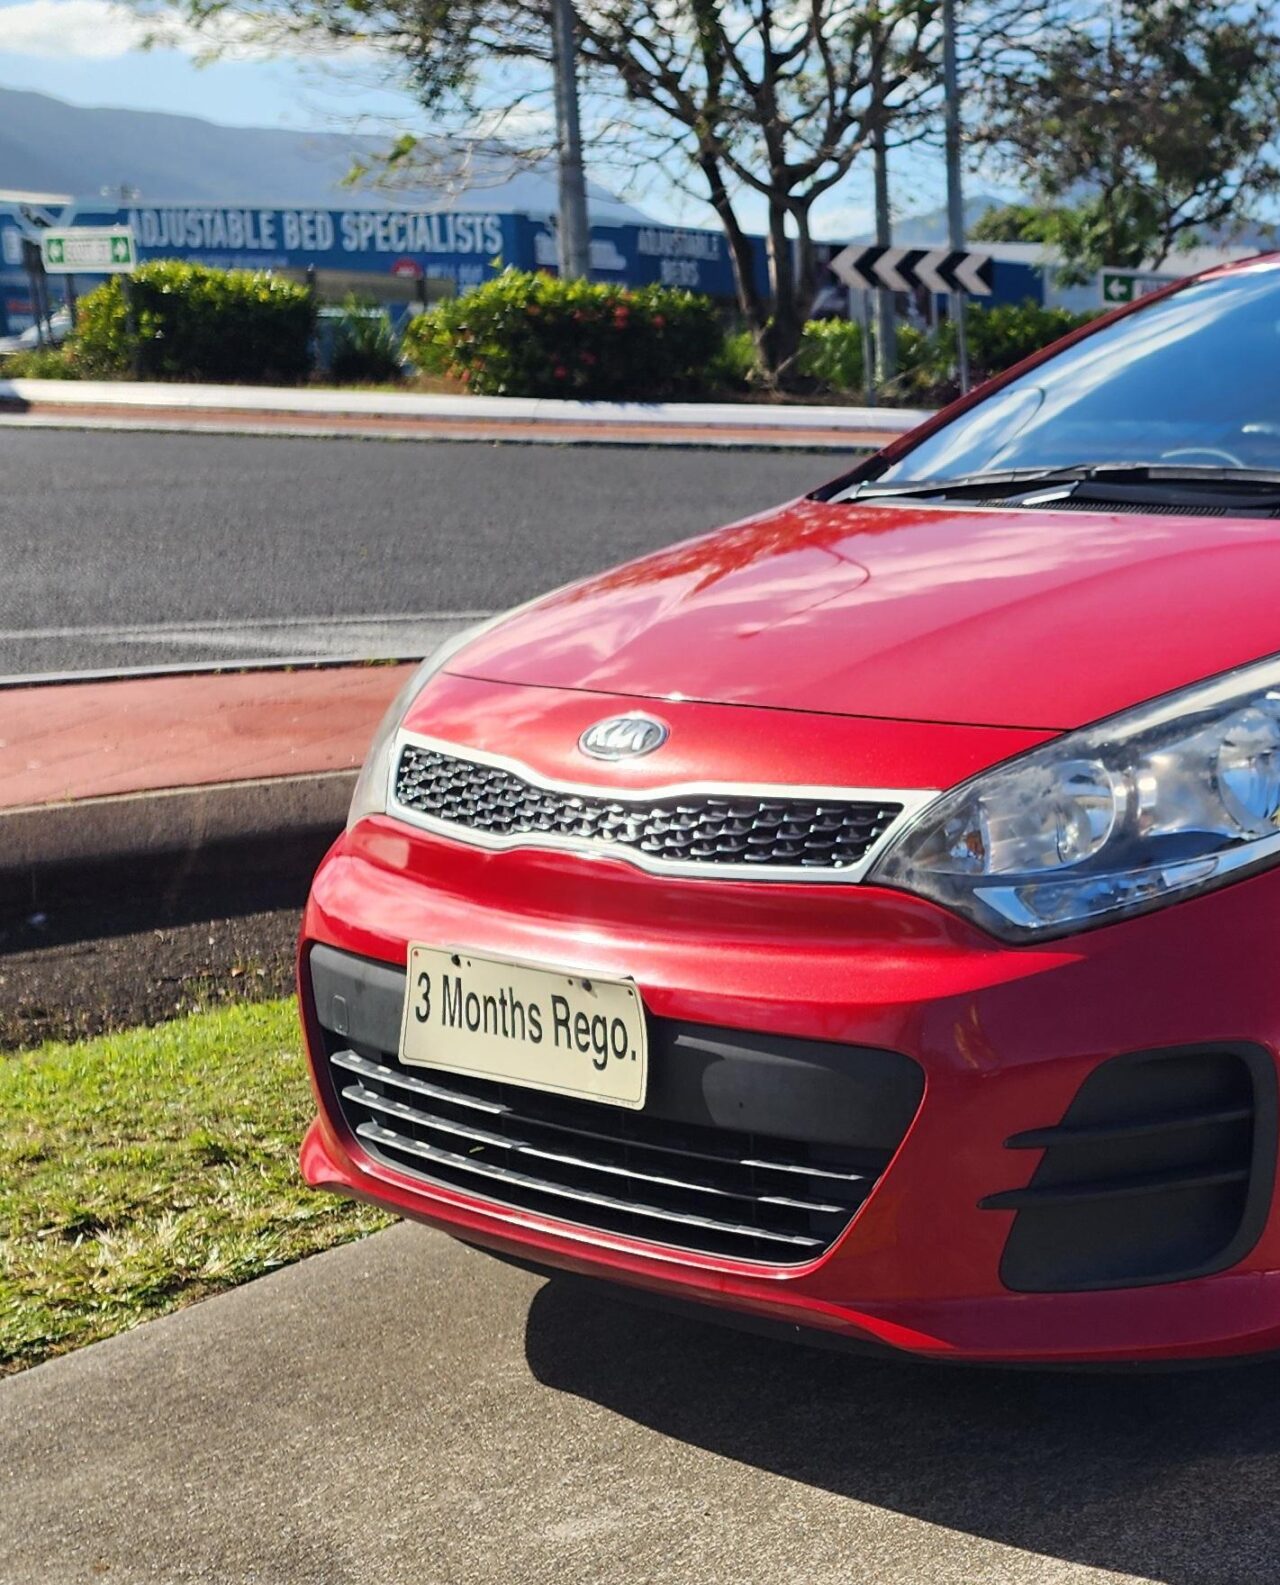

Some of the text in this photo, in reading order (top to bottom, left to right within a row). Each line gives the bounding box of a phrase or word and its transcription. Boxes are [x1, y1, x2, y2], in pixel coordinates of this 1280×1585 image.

[128, 208, 503, 254] ADJUSTABLE BED SPECIALISTS
[414, 971, 637, 1071] 3 Months Rego.
